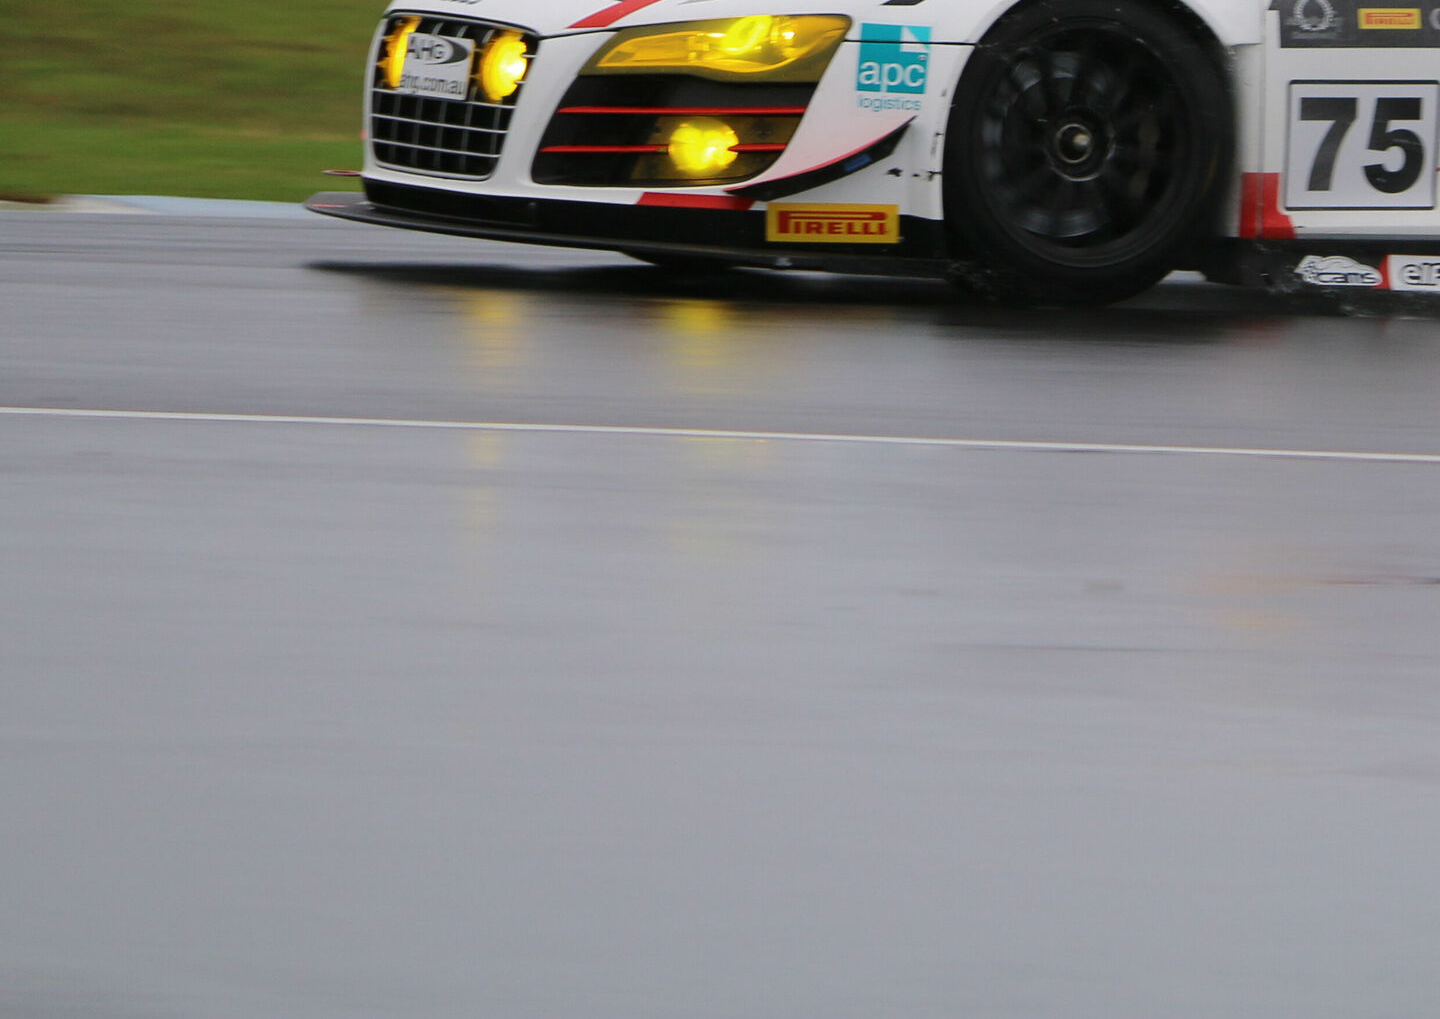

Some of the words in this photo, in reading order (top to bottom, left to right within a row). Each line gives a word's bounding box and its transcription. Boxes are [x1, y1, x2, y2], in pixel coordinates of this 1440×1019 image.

[1365, 12, 1415, 25] PIRELLI
[407, 37, 445, 60] AHG
[859, 61, 926, 92] apc
[857, 94, 921, 112] logistics
[1300, 97, 1424, 193] 75
[778, 210, 888, 235] PIRELLI
